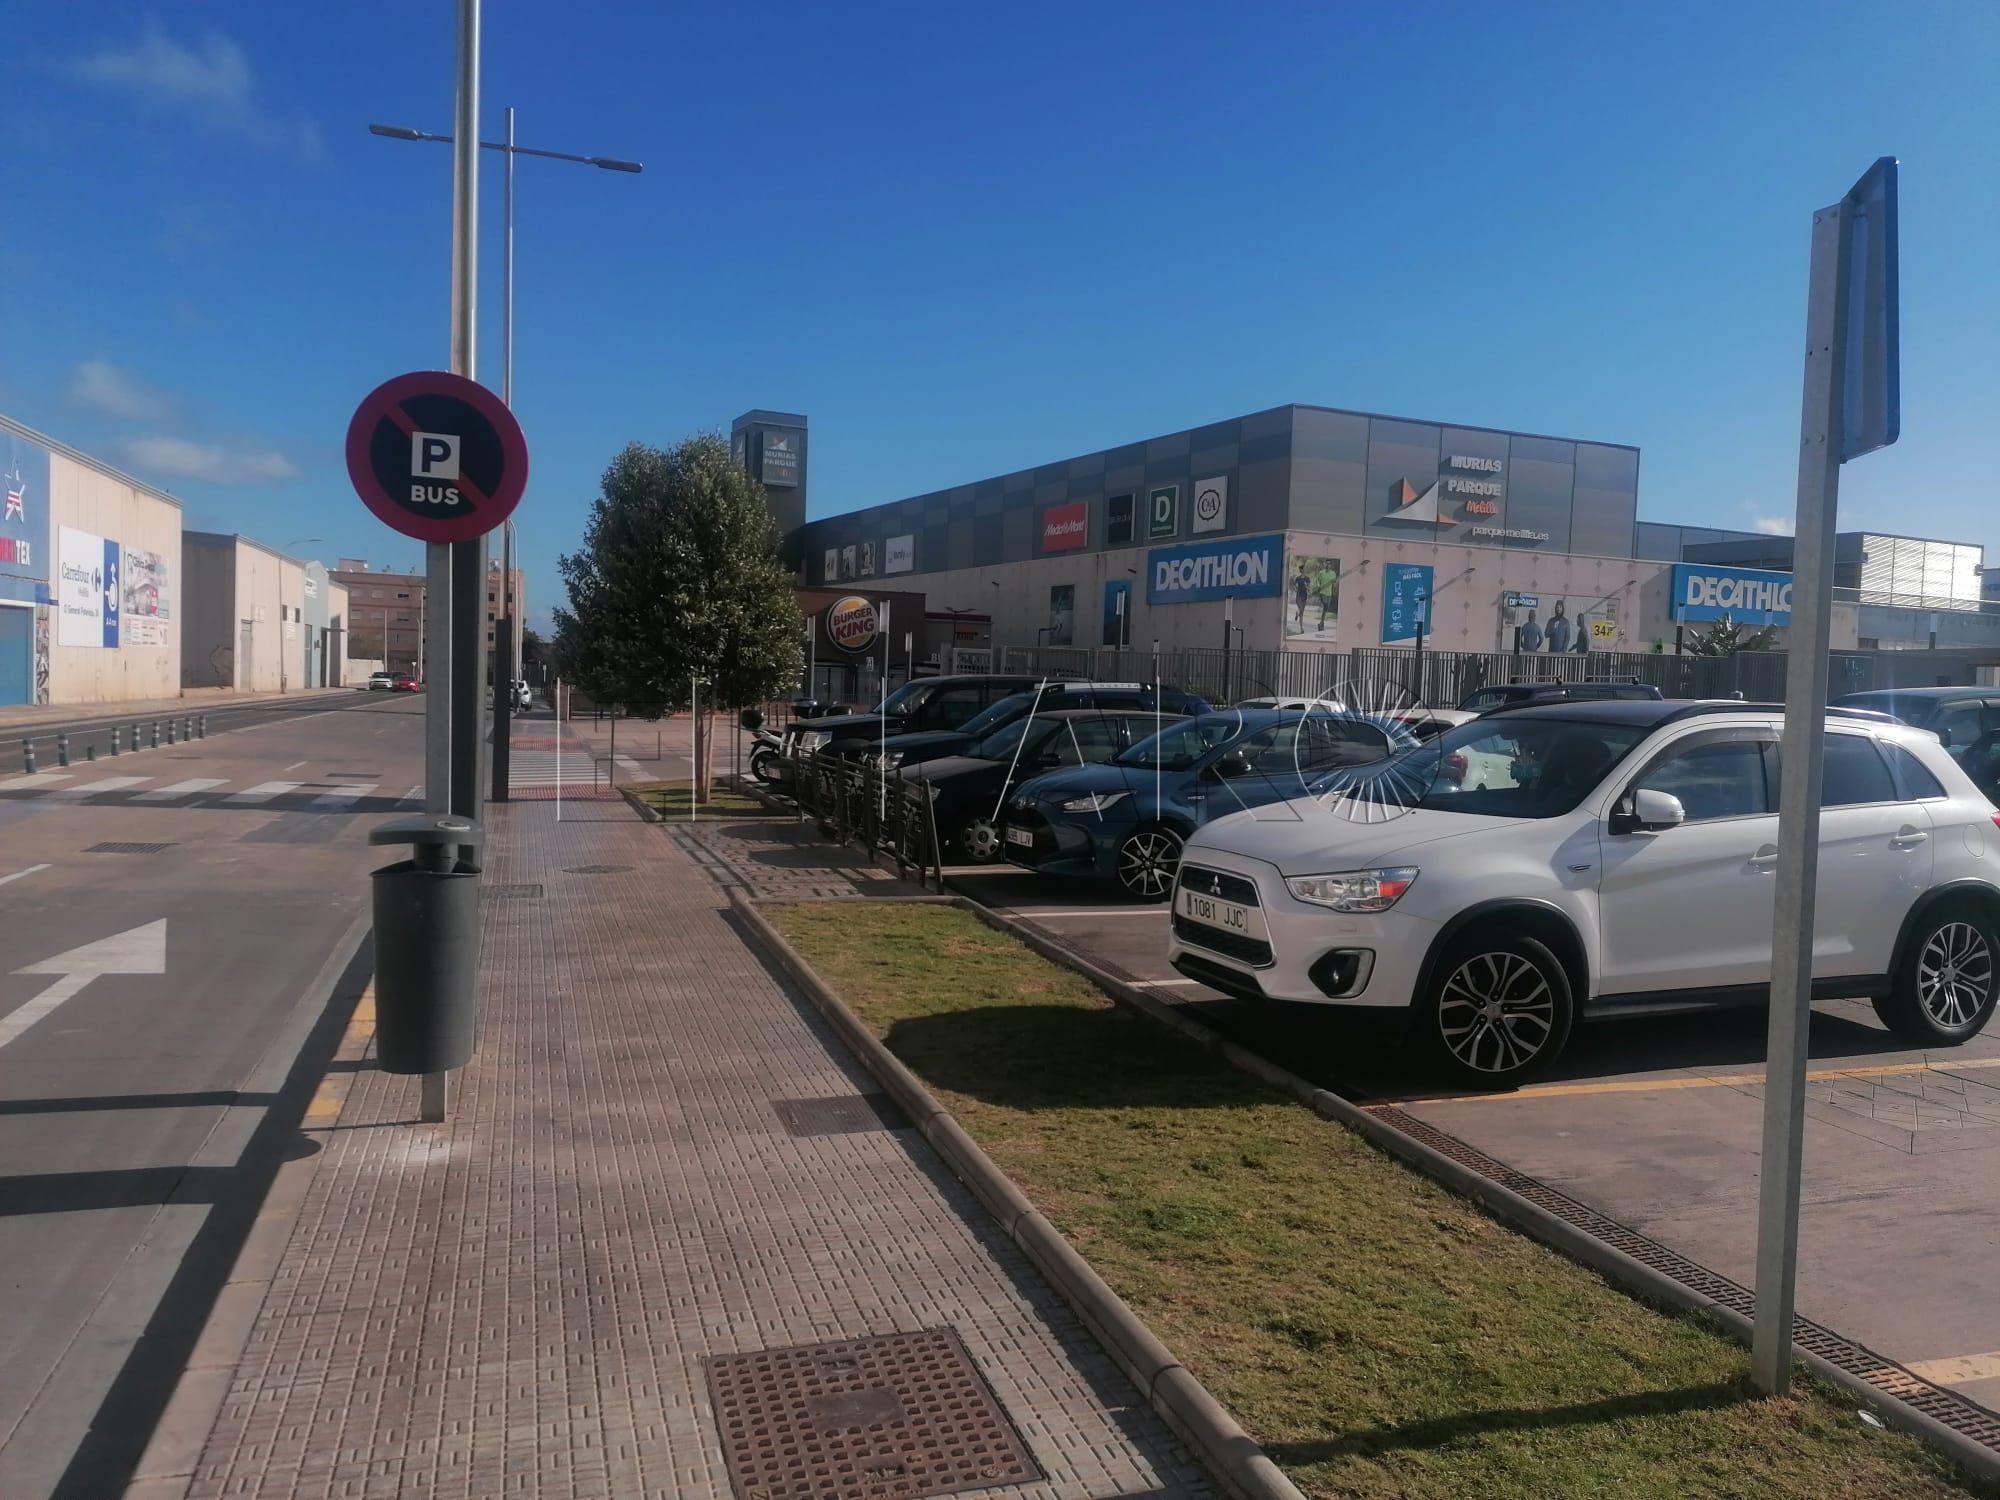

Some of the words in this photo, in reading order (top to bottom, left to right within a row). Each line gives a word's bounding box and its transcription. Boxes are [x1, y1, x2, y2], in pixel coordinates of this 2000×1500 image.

[421, 437, 452, 473] P
[764, 450, 797, 460] MURIAS
[764, 458, 797, 468] PARQUE
[1450, 455, 1502, 472] MURIAS
[411, 485, 459, 505] BUS
[1447, 479, 1502, 496] PARQUE
[1155, 495, 1171, 523] D
[1201, 497, 1217, 513] C&A
[1466, 500, 1498, 514] Melilla
[61, 561, 90, 584] Carrefour
[1155, 550, 1269, 592] DECATHLON
[1686, 575, 1793, 612] DECATHLO
[833, 607, 873, 627] BURGER
[835, 618, 875, 641] KING
[1193, 898, 1216, 921] 1081
[1223, 906, 1244, 928] JJC
